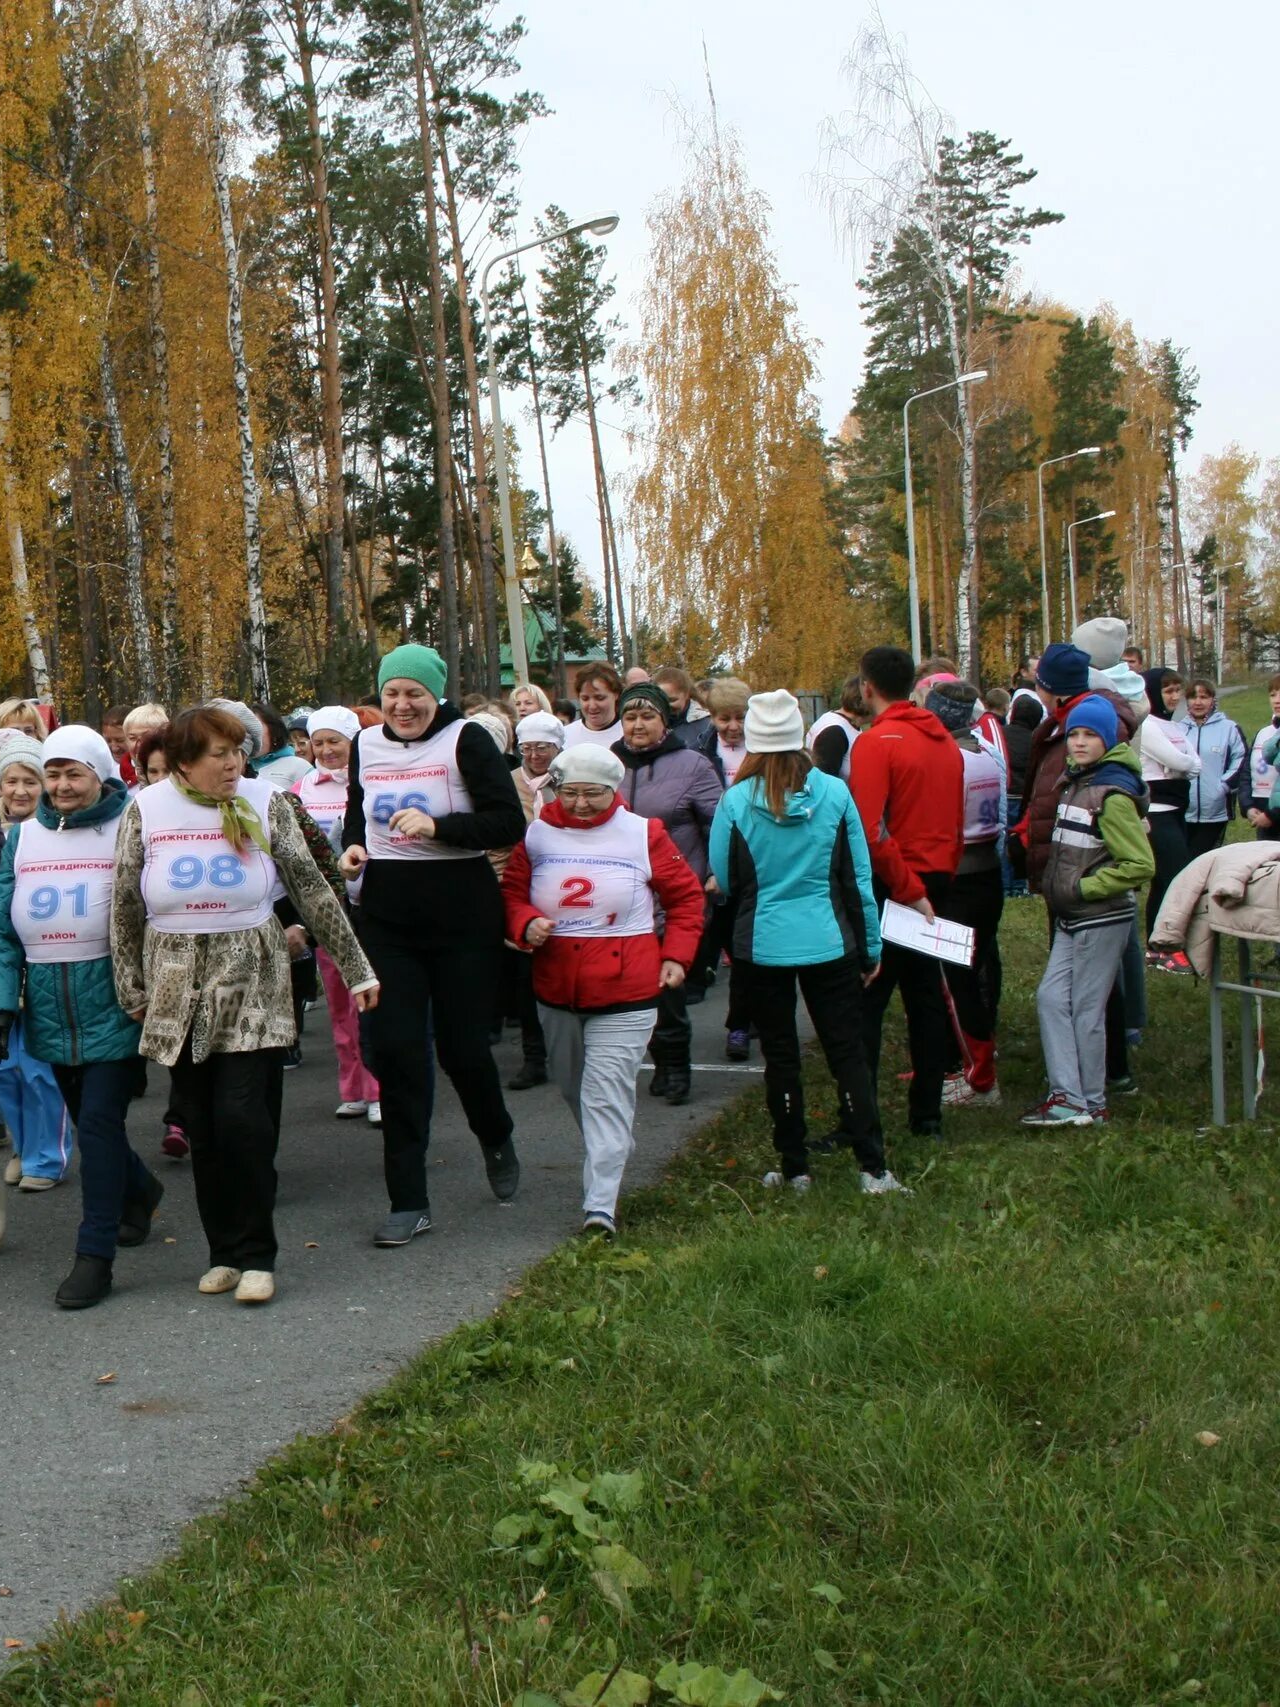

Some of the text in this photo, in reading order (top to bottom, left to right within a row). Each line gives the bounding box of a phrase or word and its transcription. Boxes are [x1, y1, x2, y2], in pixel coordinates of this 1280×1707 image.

[366, 769, 446, 781] НИЖНЕТАВДИНСКИЙ
[21, 862, 114, 873] НИЖНЕТАВДИНСКИЙ
[167, 853, 246, 890] 98
[558, 876, 594, 908] 2
[27, 881, 88, 921] 91
[186, 902, 226, 910] РАЙОН
[606, 912, 618, 926] 1
[42, 932, 76, 940] РАЙОН
